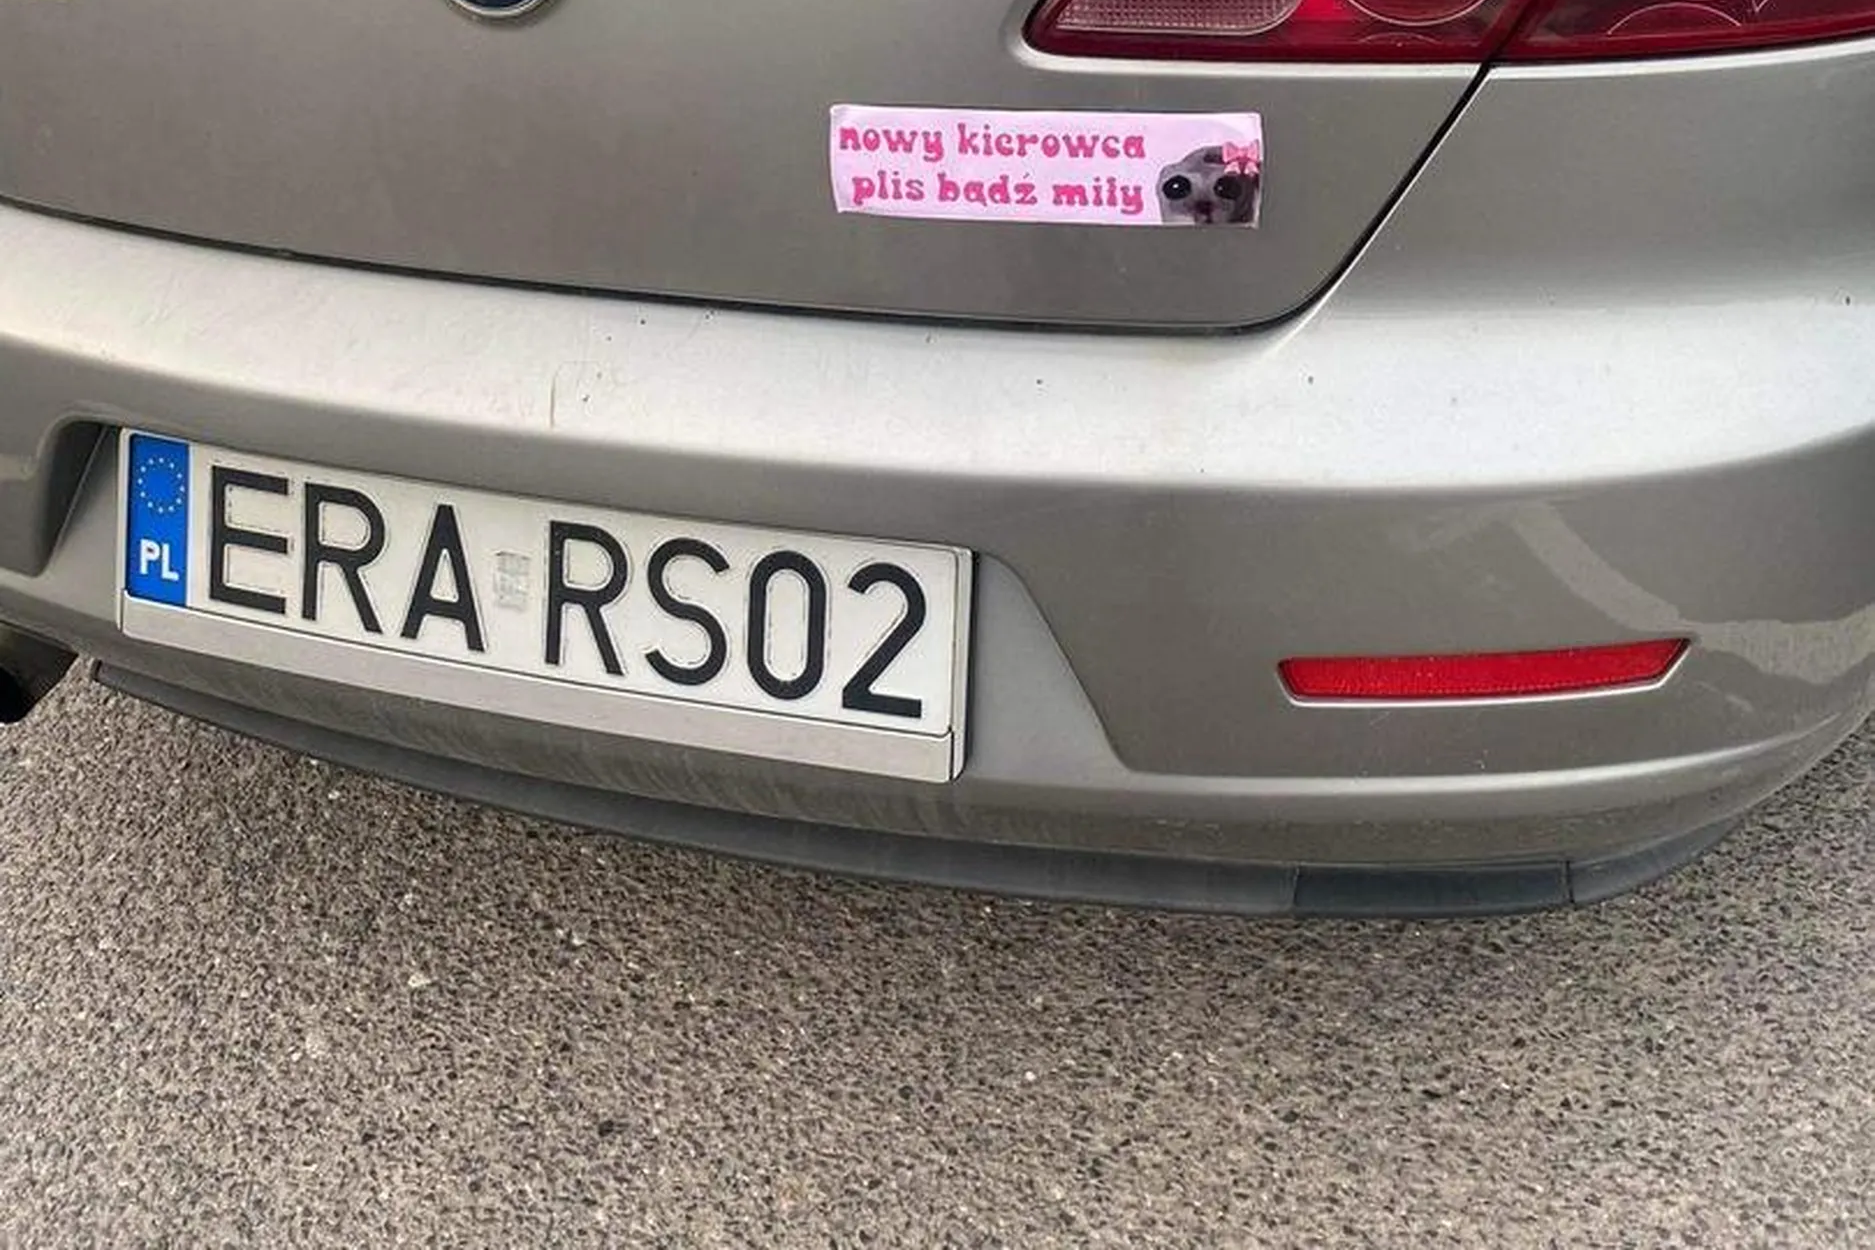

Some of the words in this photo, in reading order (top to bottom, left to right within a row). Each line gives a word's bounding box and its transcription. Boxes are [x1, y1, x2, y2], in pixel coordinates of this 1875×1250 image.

[838, 122, 945, 161] nowy
[957, 123, 1147, 159] kierowca
[852, 170, 926, 206] plis
[140, 538, 180, 581] PL
[208, 464, 486, 653] ERA
[543, 519, 924, 720] RS02
